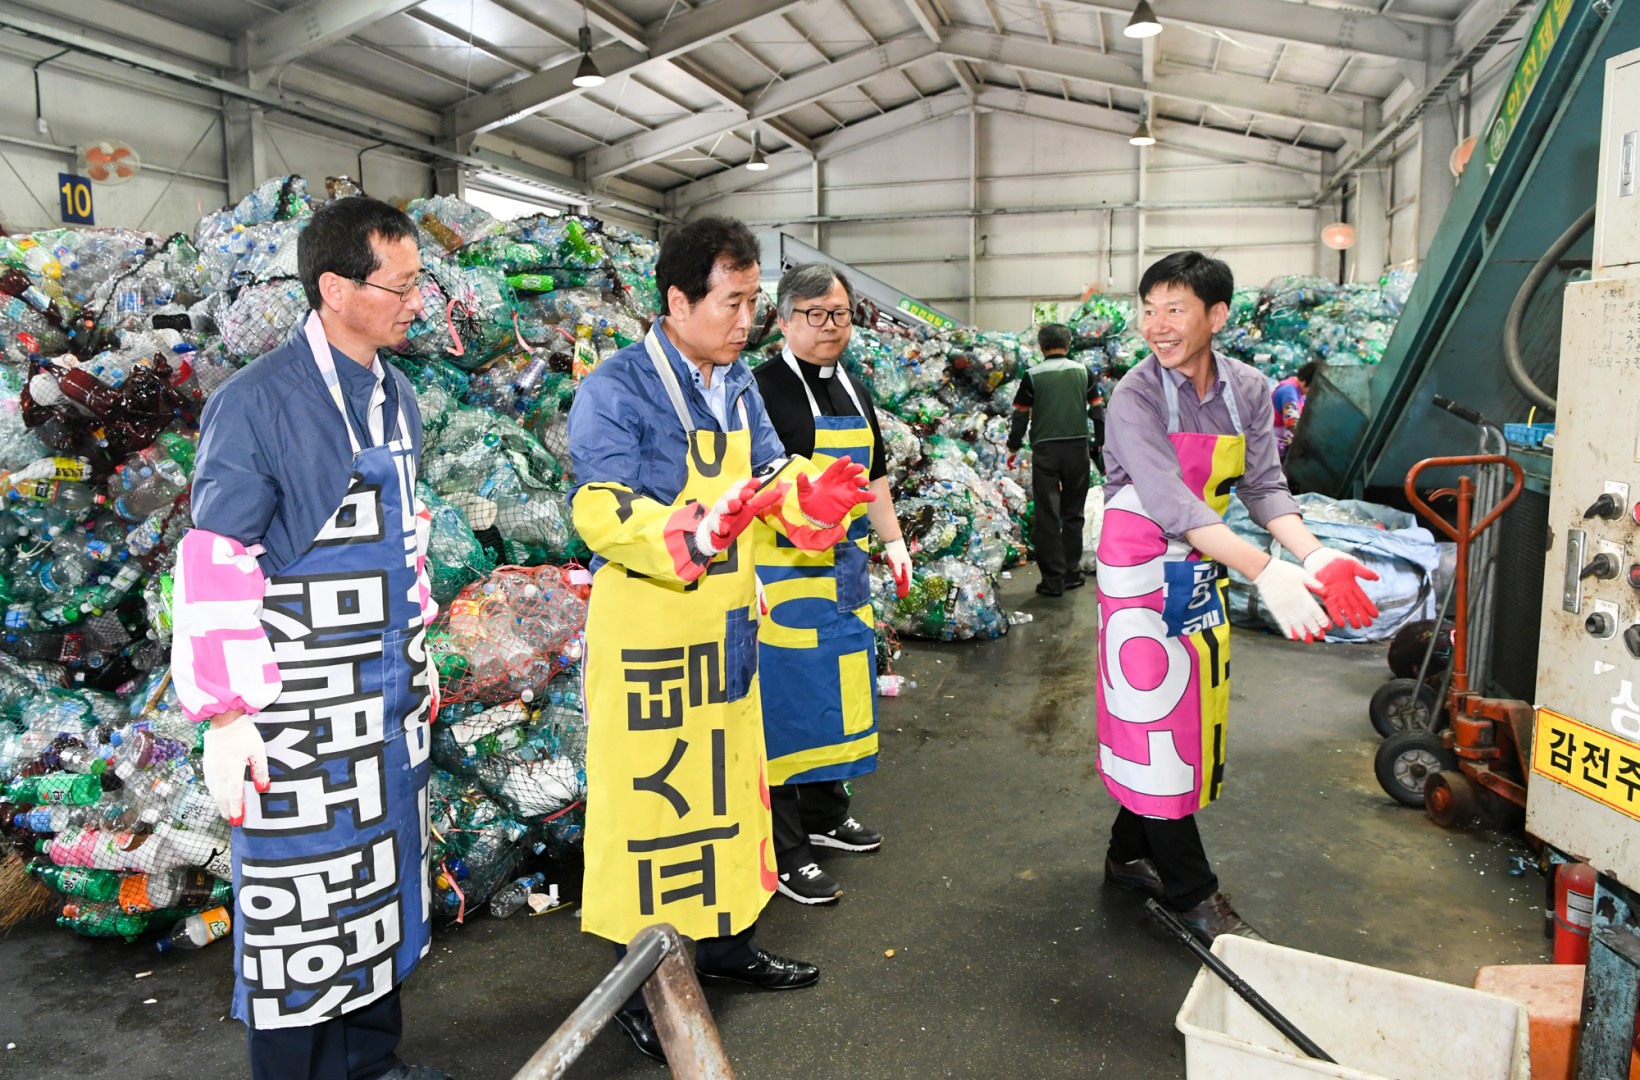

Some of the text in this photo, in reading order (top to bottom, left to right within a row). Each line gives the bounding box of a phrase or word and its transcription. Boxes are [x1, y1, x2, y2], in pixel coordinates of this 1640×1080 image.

[61, 182, 91, 218] 10
[1549, 728, 1640, 803] 감전주
[240, 836, 400, 1030] 조합원
